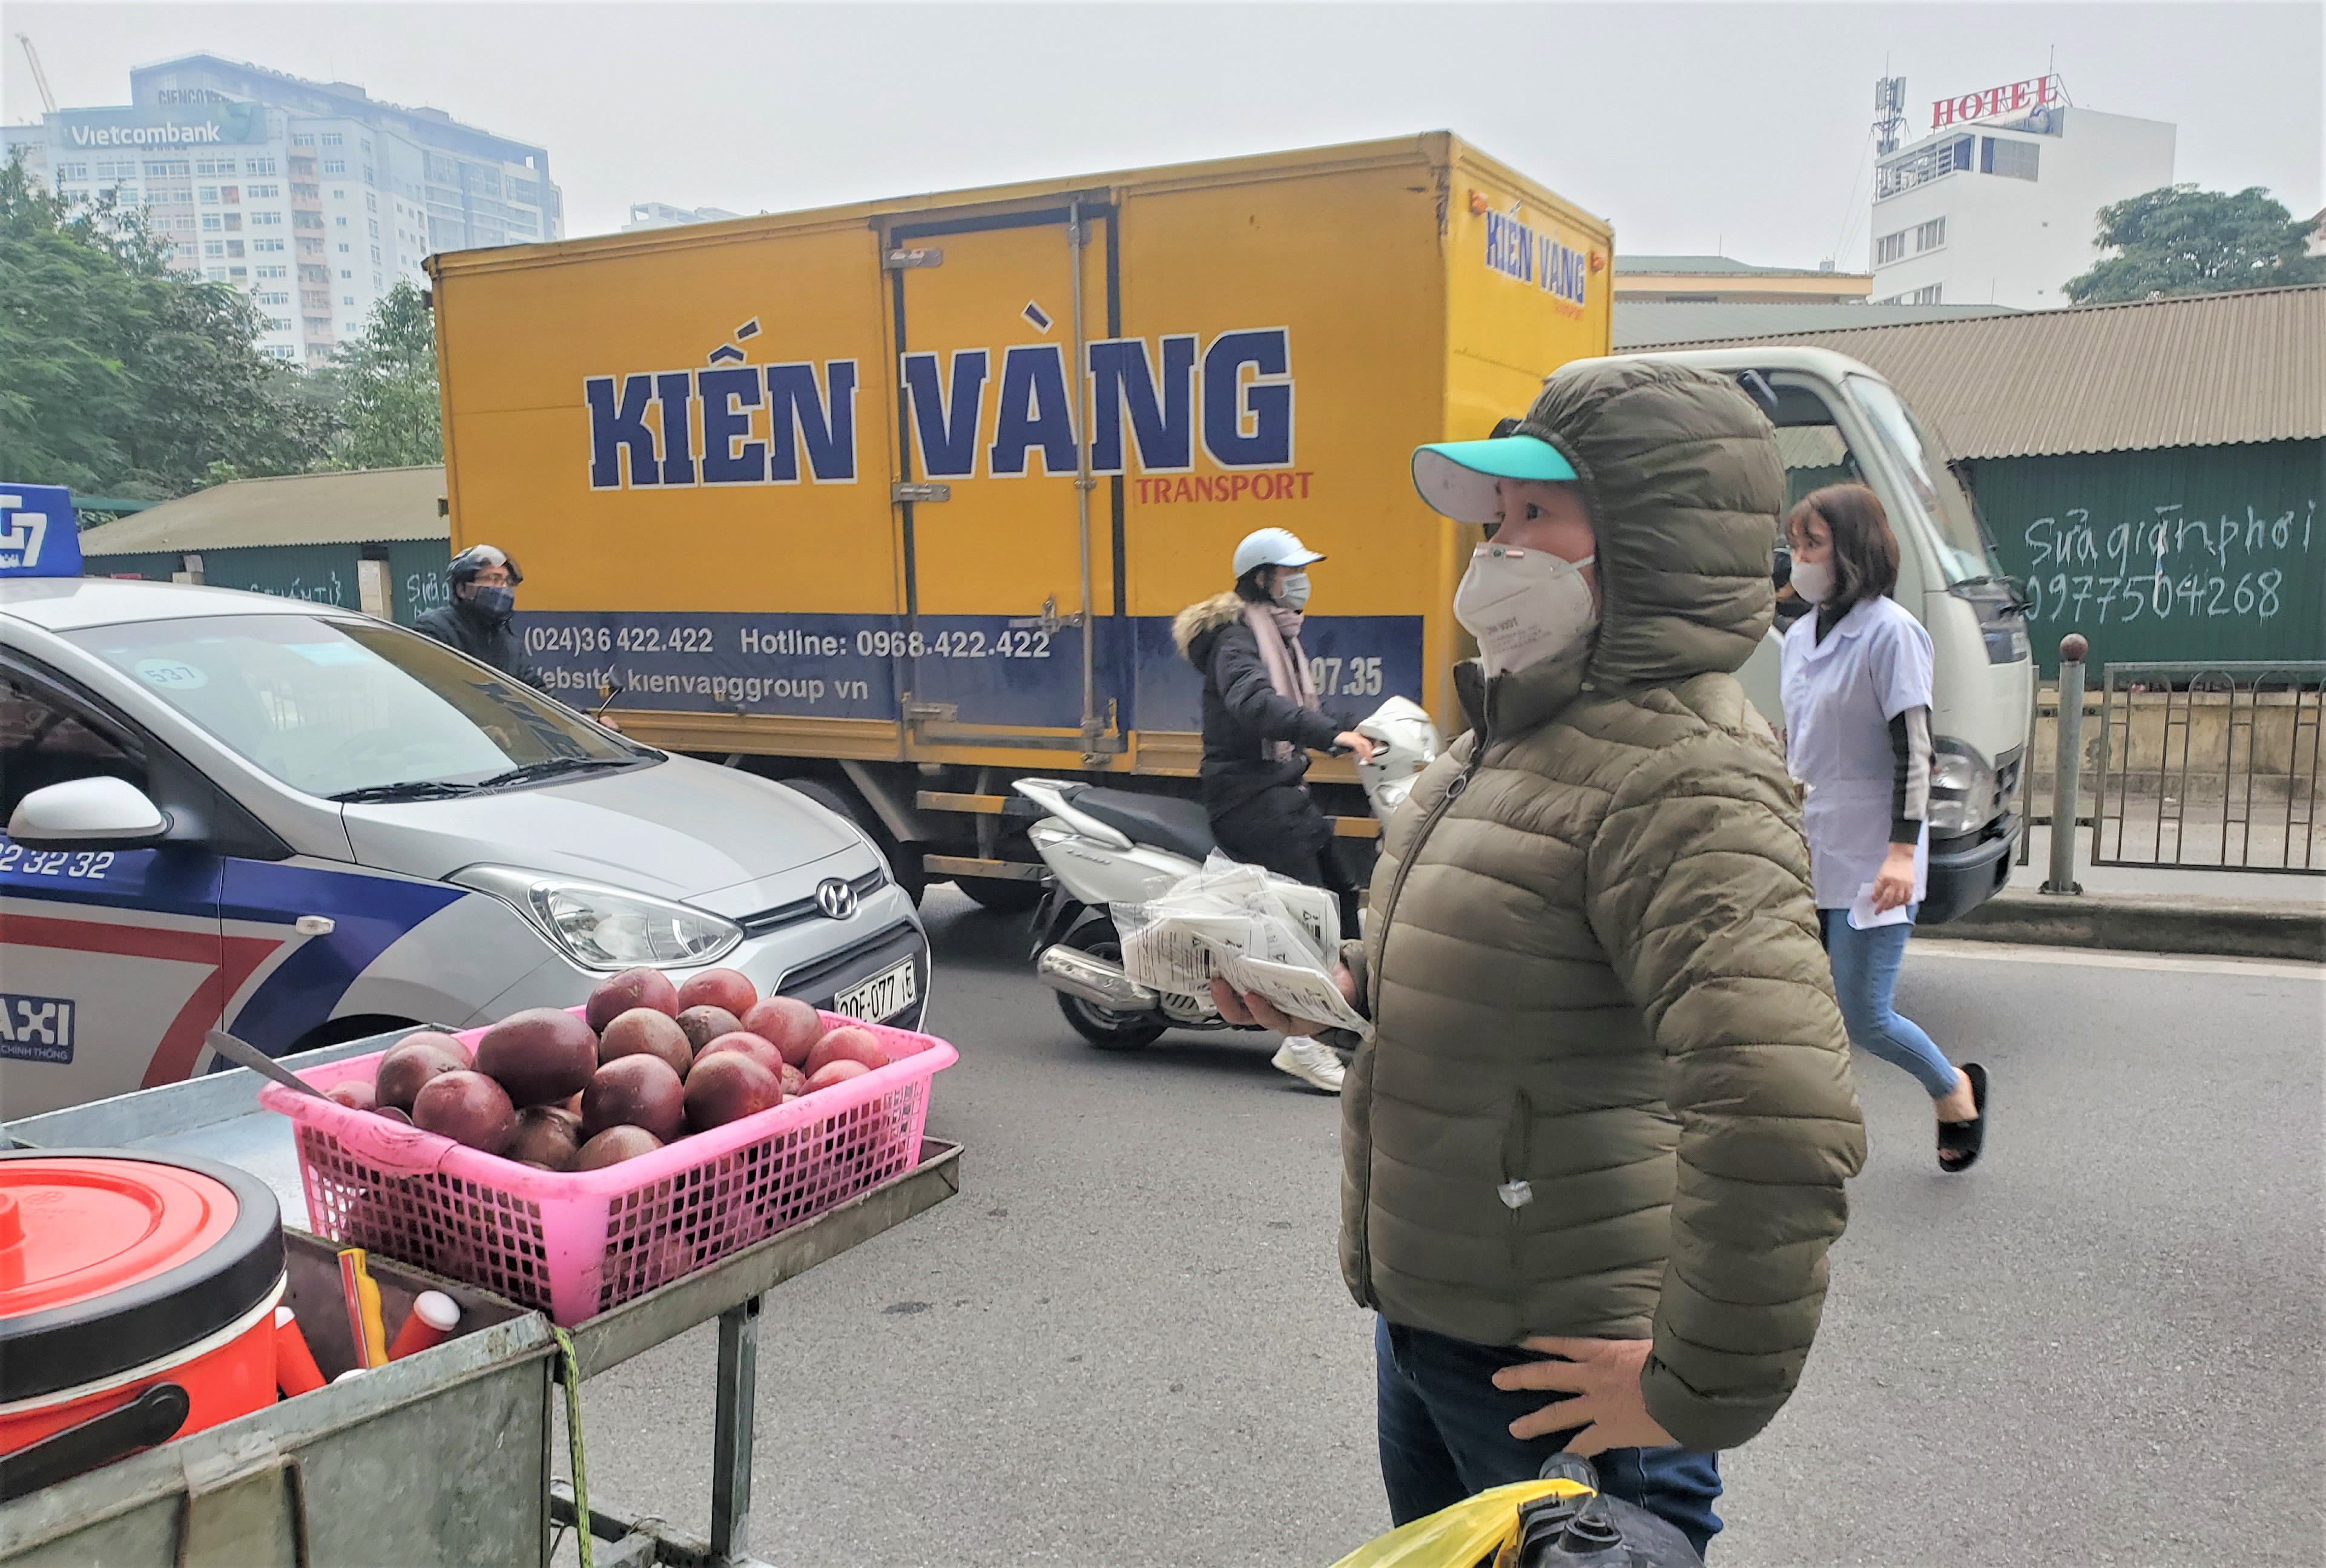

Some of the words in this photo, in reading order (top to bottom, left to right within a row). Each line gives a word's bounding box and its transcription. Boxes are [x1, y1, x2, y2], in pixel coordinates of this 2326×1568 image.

[1931, 76, 2057, 128] HOTEL
[71, 120, 221, 146] Vietcombank
[584, 315, 858, 492] KIẾN
[900, 300, 1295, 480] VÀNG
[1135, 472, 1314, 504] TRANSPORT
[2218, 499, 2316, 572] phơi
[2024, 568, 2282, 625] 0977504268
[740, 628, 847, 655] Hotline:
[856, 630, 1051, 658] 0968.422.422
[144, 667, 196, 682] 537
[68, 851, 115, 879] 32
